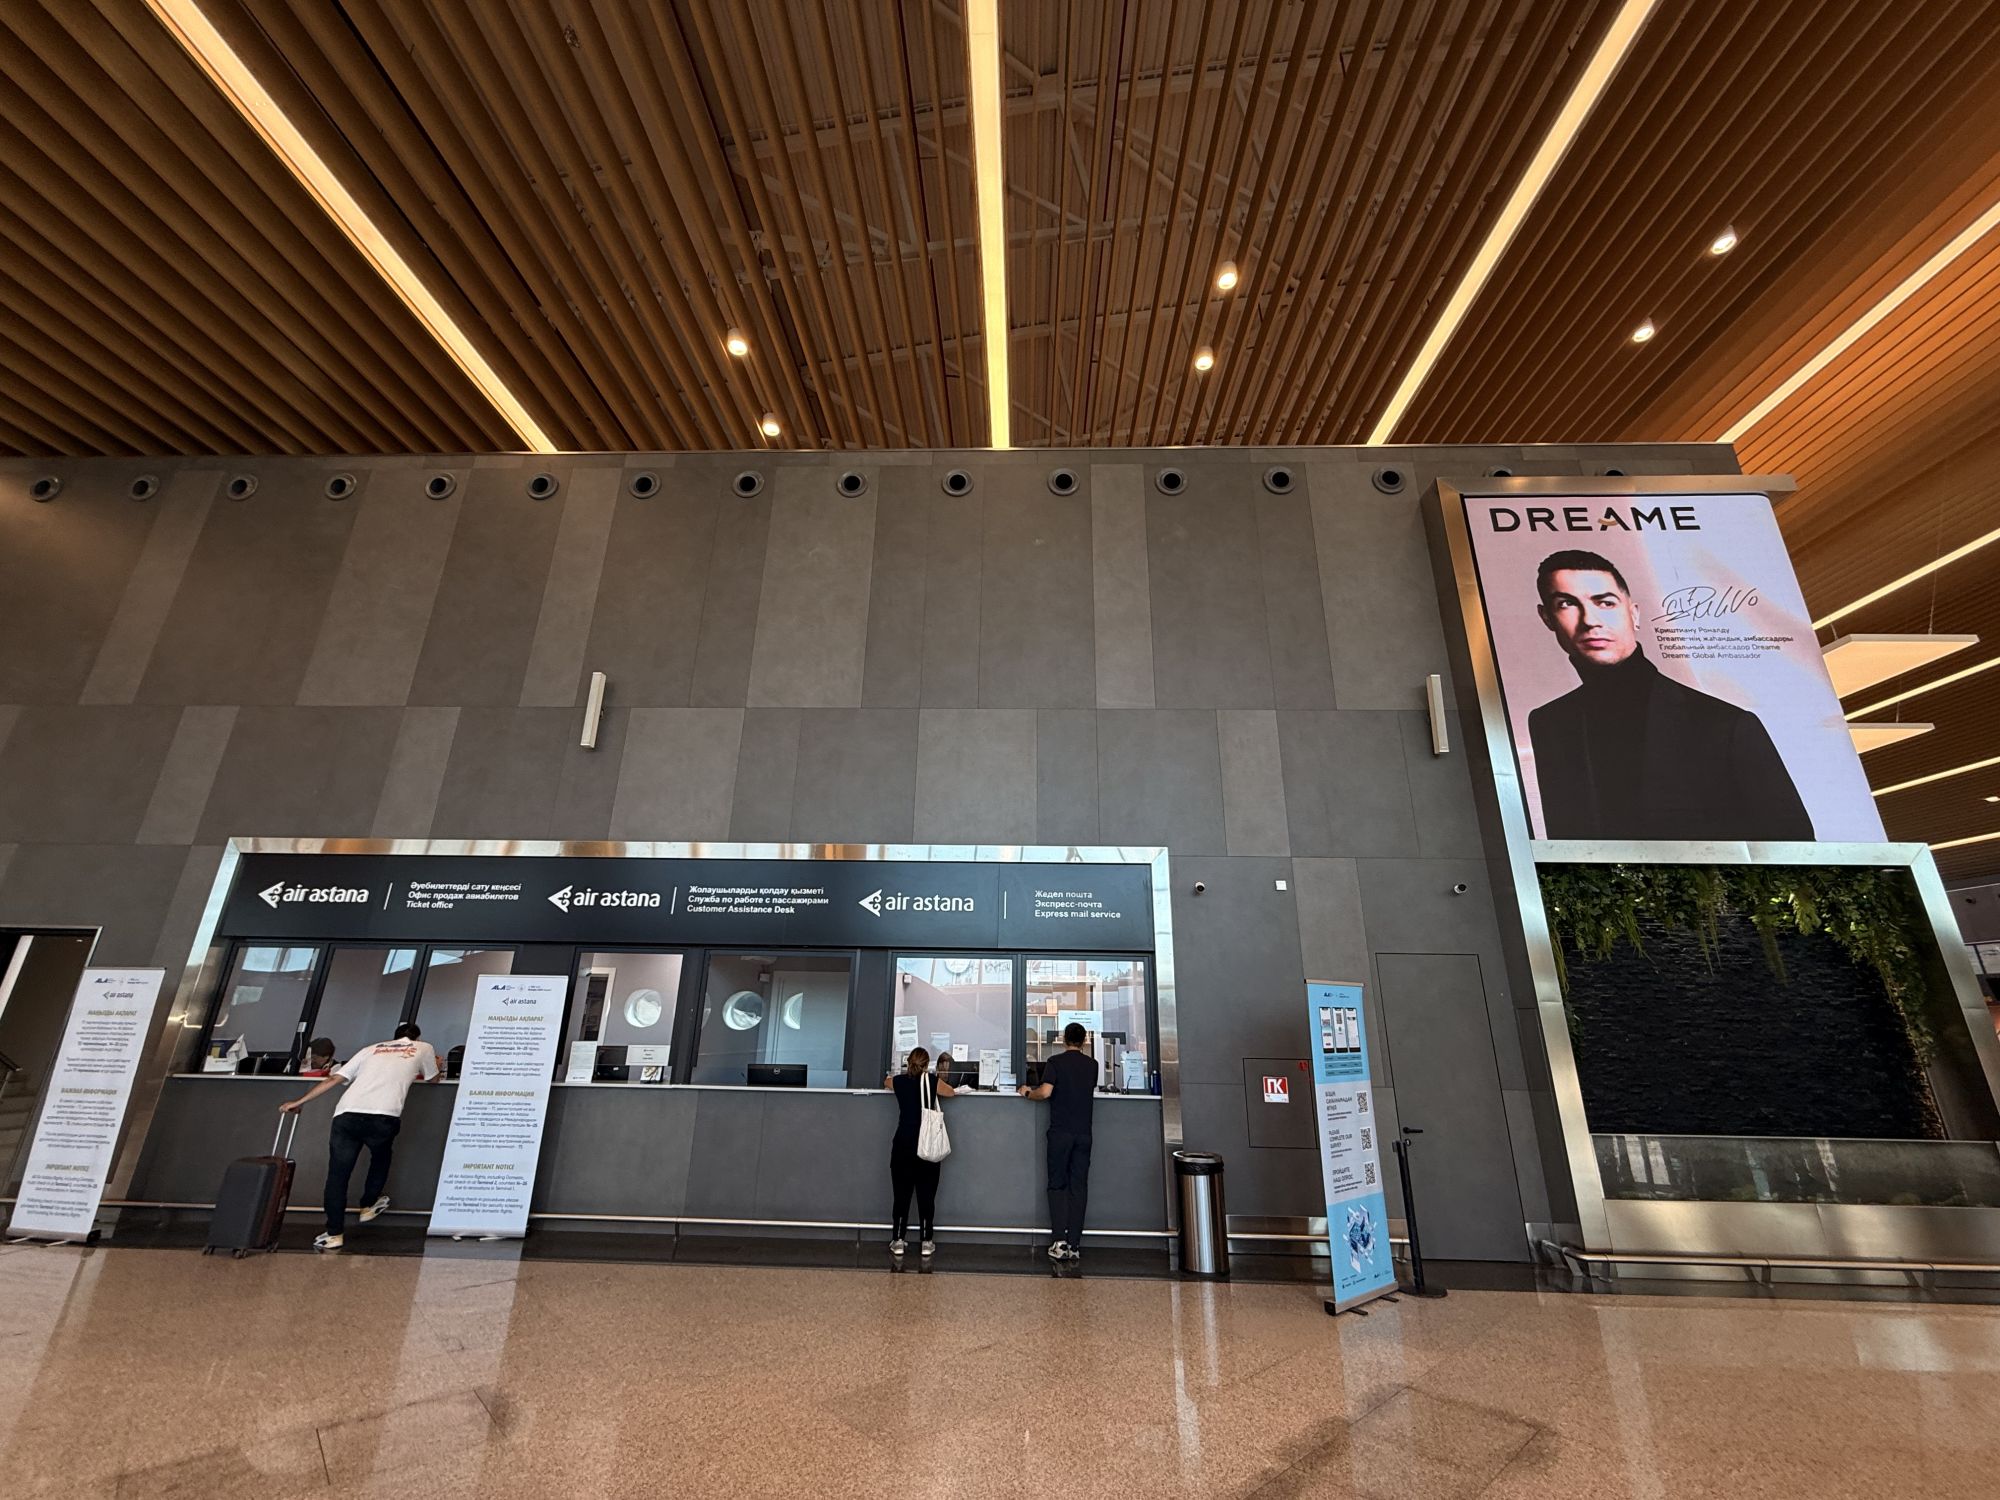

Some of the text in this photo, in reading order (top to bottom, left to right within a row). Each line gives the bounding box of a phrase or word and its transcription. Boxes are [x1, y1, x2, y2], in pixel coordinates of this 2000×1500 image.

[1489, 506, 1701, 532] DREAME
[1743, 635, 1794, 643] амбассадоры
[410, 881, 522, 892] Әуебилеттерді сату кеңсесі
[689, 886, 824, 895] Жолаушыларды қолдау қызметі
[283, 884, 370, 903] air astana
[408, 891, 519, 900] Офис продаж авиабилетов
[573, 888, 661, 907] air astana
[1035, 890, 1063, 899] Жедел
[688, 895, 720, 904] Служба
[734, 896, 763, 904] работе
[885, 892, 974, 911] air astana
[1035, 899, 1103, 909] Экспресс-почта
[431, 901, 454, 909] office
[727, 905, 772, 913] Assistance
[774, 906, 795, 914] Desk
[1034, 910, 1121, 918] Express mail service
[1267, 1078, 1284, 1094] ПК
